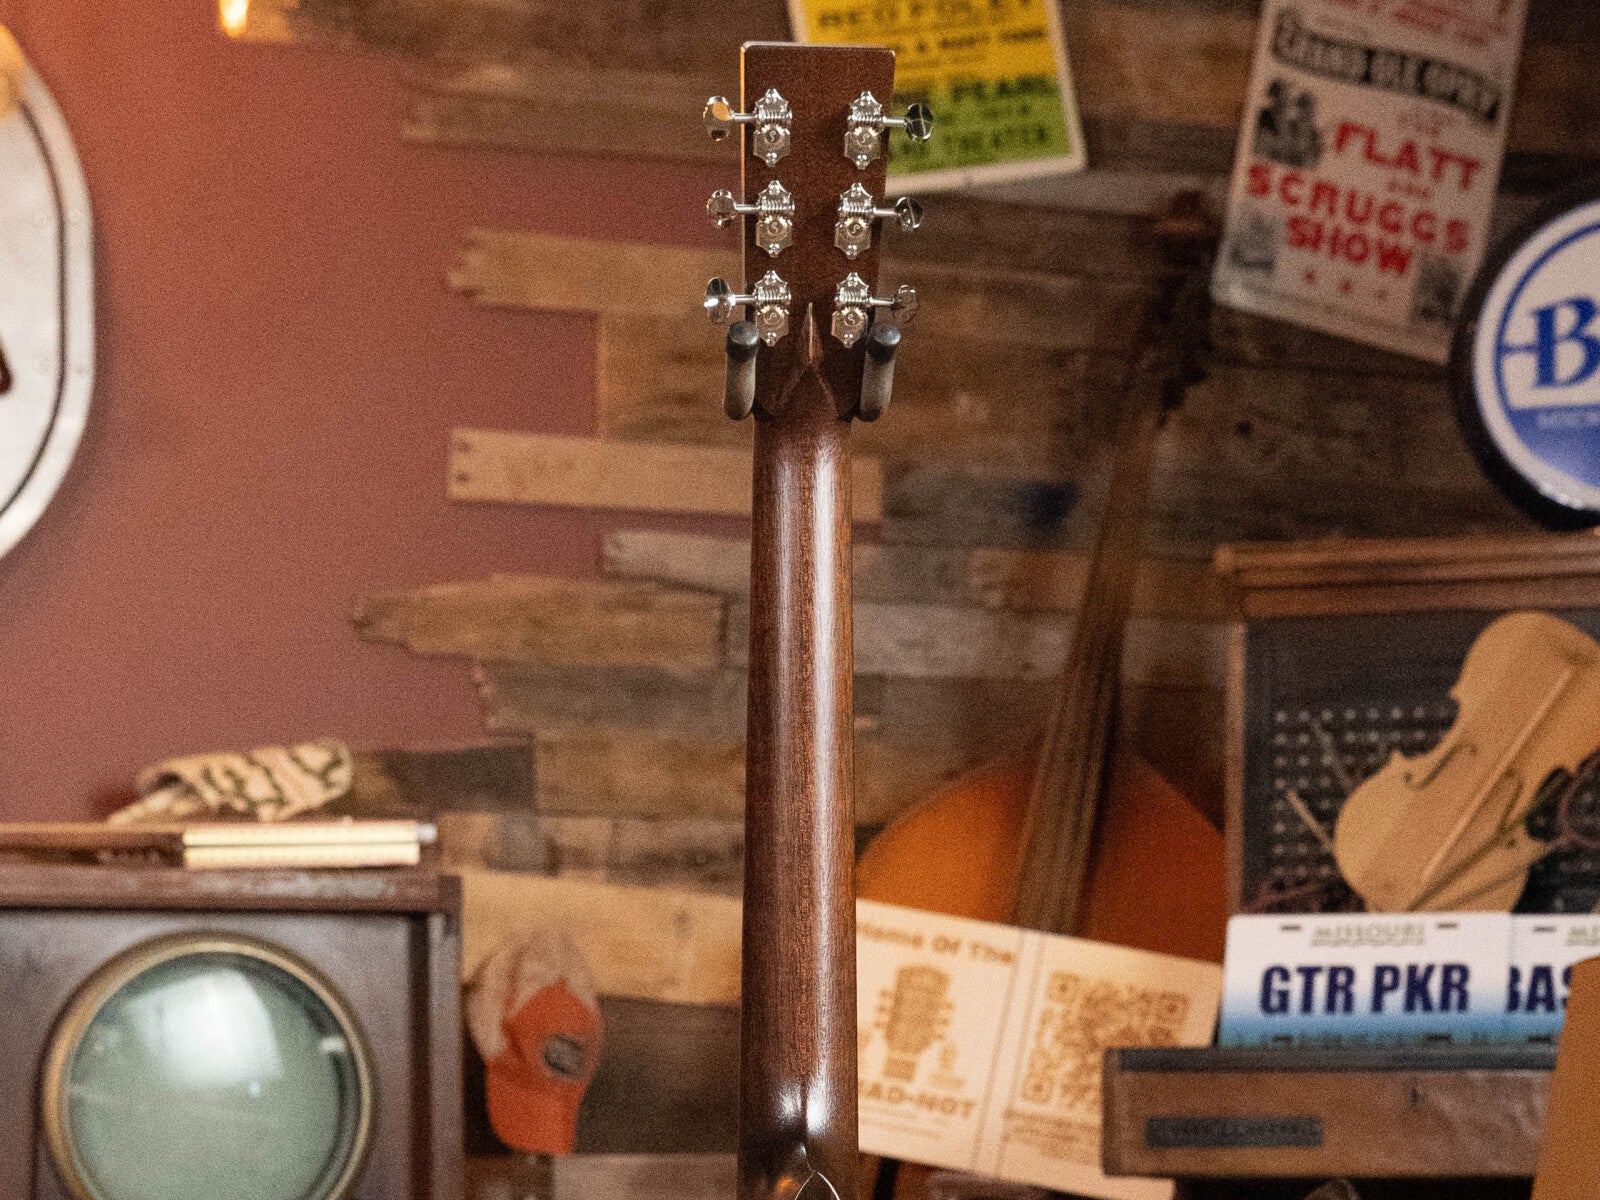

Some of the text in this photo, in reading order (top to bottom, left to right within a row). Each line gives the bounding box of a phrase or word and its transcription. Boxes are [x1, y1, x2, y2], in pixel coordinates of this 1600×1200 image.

[1335, 120, 1482, 193] FLATT
[1247, 161, 1471, 252] SCRUGGS
[1286, 214, 1413, 277] SHOW
[1259, 963, 1471, 1016] GTR PKR
